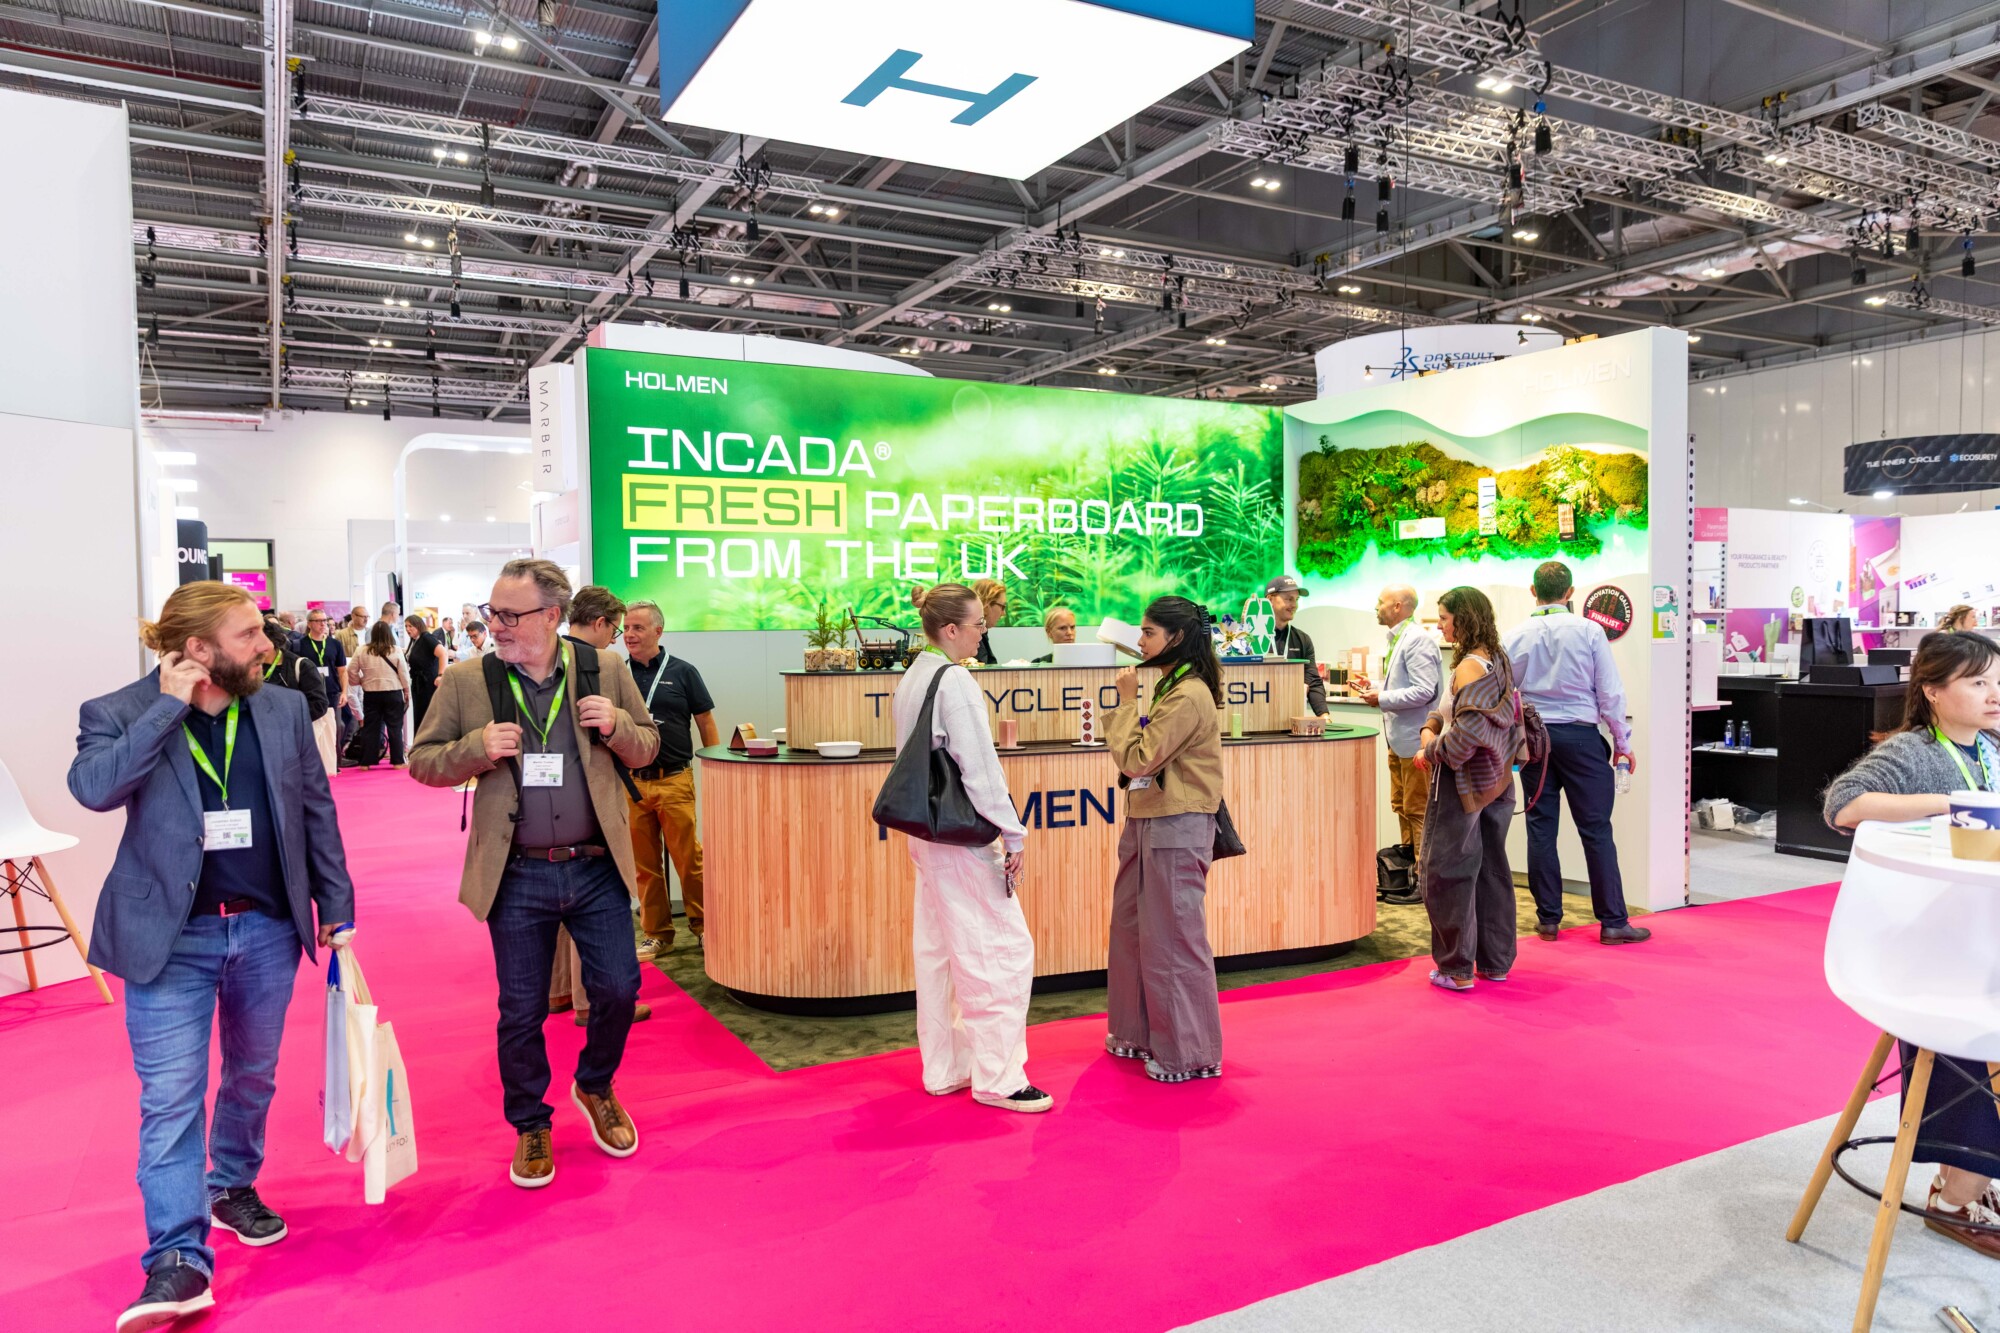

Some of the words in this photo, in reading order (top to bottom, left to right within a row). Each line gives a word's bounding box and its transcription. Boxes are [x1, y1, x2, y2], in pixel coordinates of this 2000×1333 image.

[840, 48, 1039, 127] H
[625, 370, 728, 395] HOLMEN
[539, 380, 552, 474] MARBER
[627, 425, 892, 479] INCADA®
[1908, 455, 1941, 465] CIRCLE
[1959, 453, 1998, 462] ECOSURETY
[629, 483, 841, 527] FRESH
[865, 491, 1205, 537] PAPERBOARD
[629, 536, 802, 578] FROM
[826, 540, 939, 579] THE
[961, 543, 1030, 580] UK
[1586, 588, 1620, 608] INNOVATION
[1618, 594, 1632, 623] GALLERY
[1590, 612, 1621, 628] FINALIST
[984, 687, 1084, 714] YCLE
[1009, 787, 1115, 830] MEN
